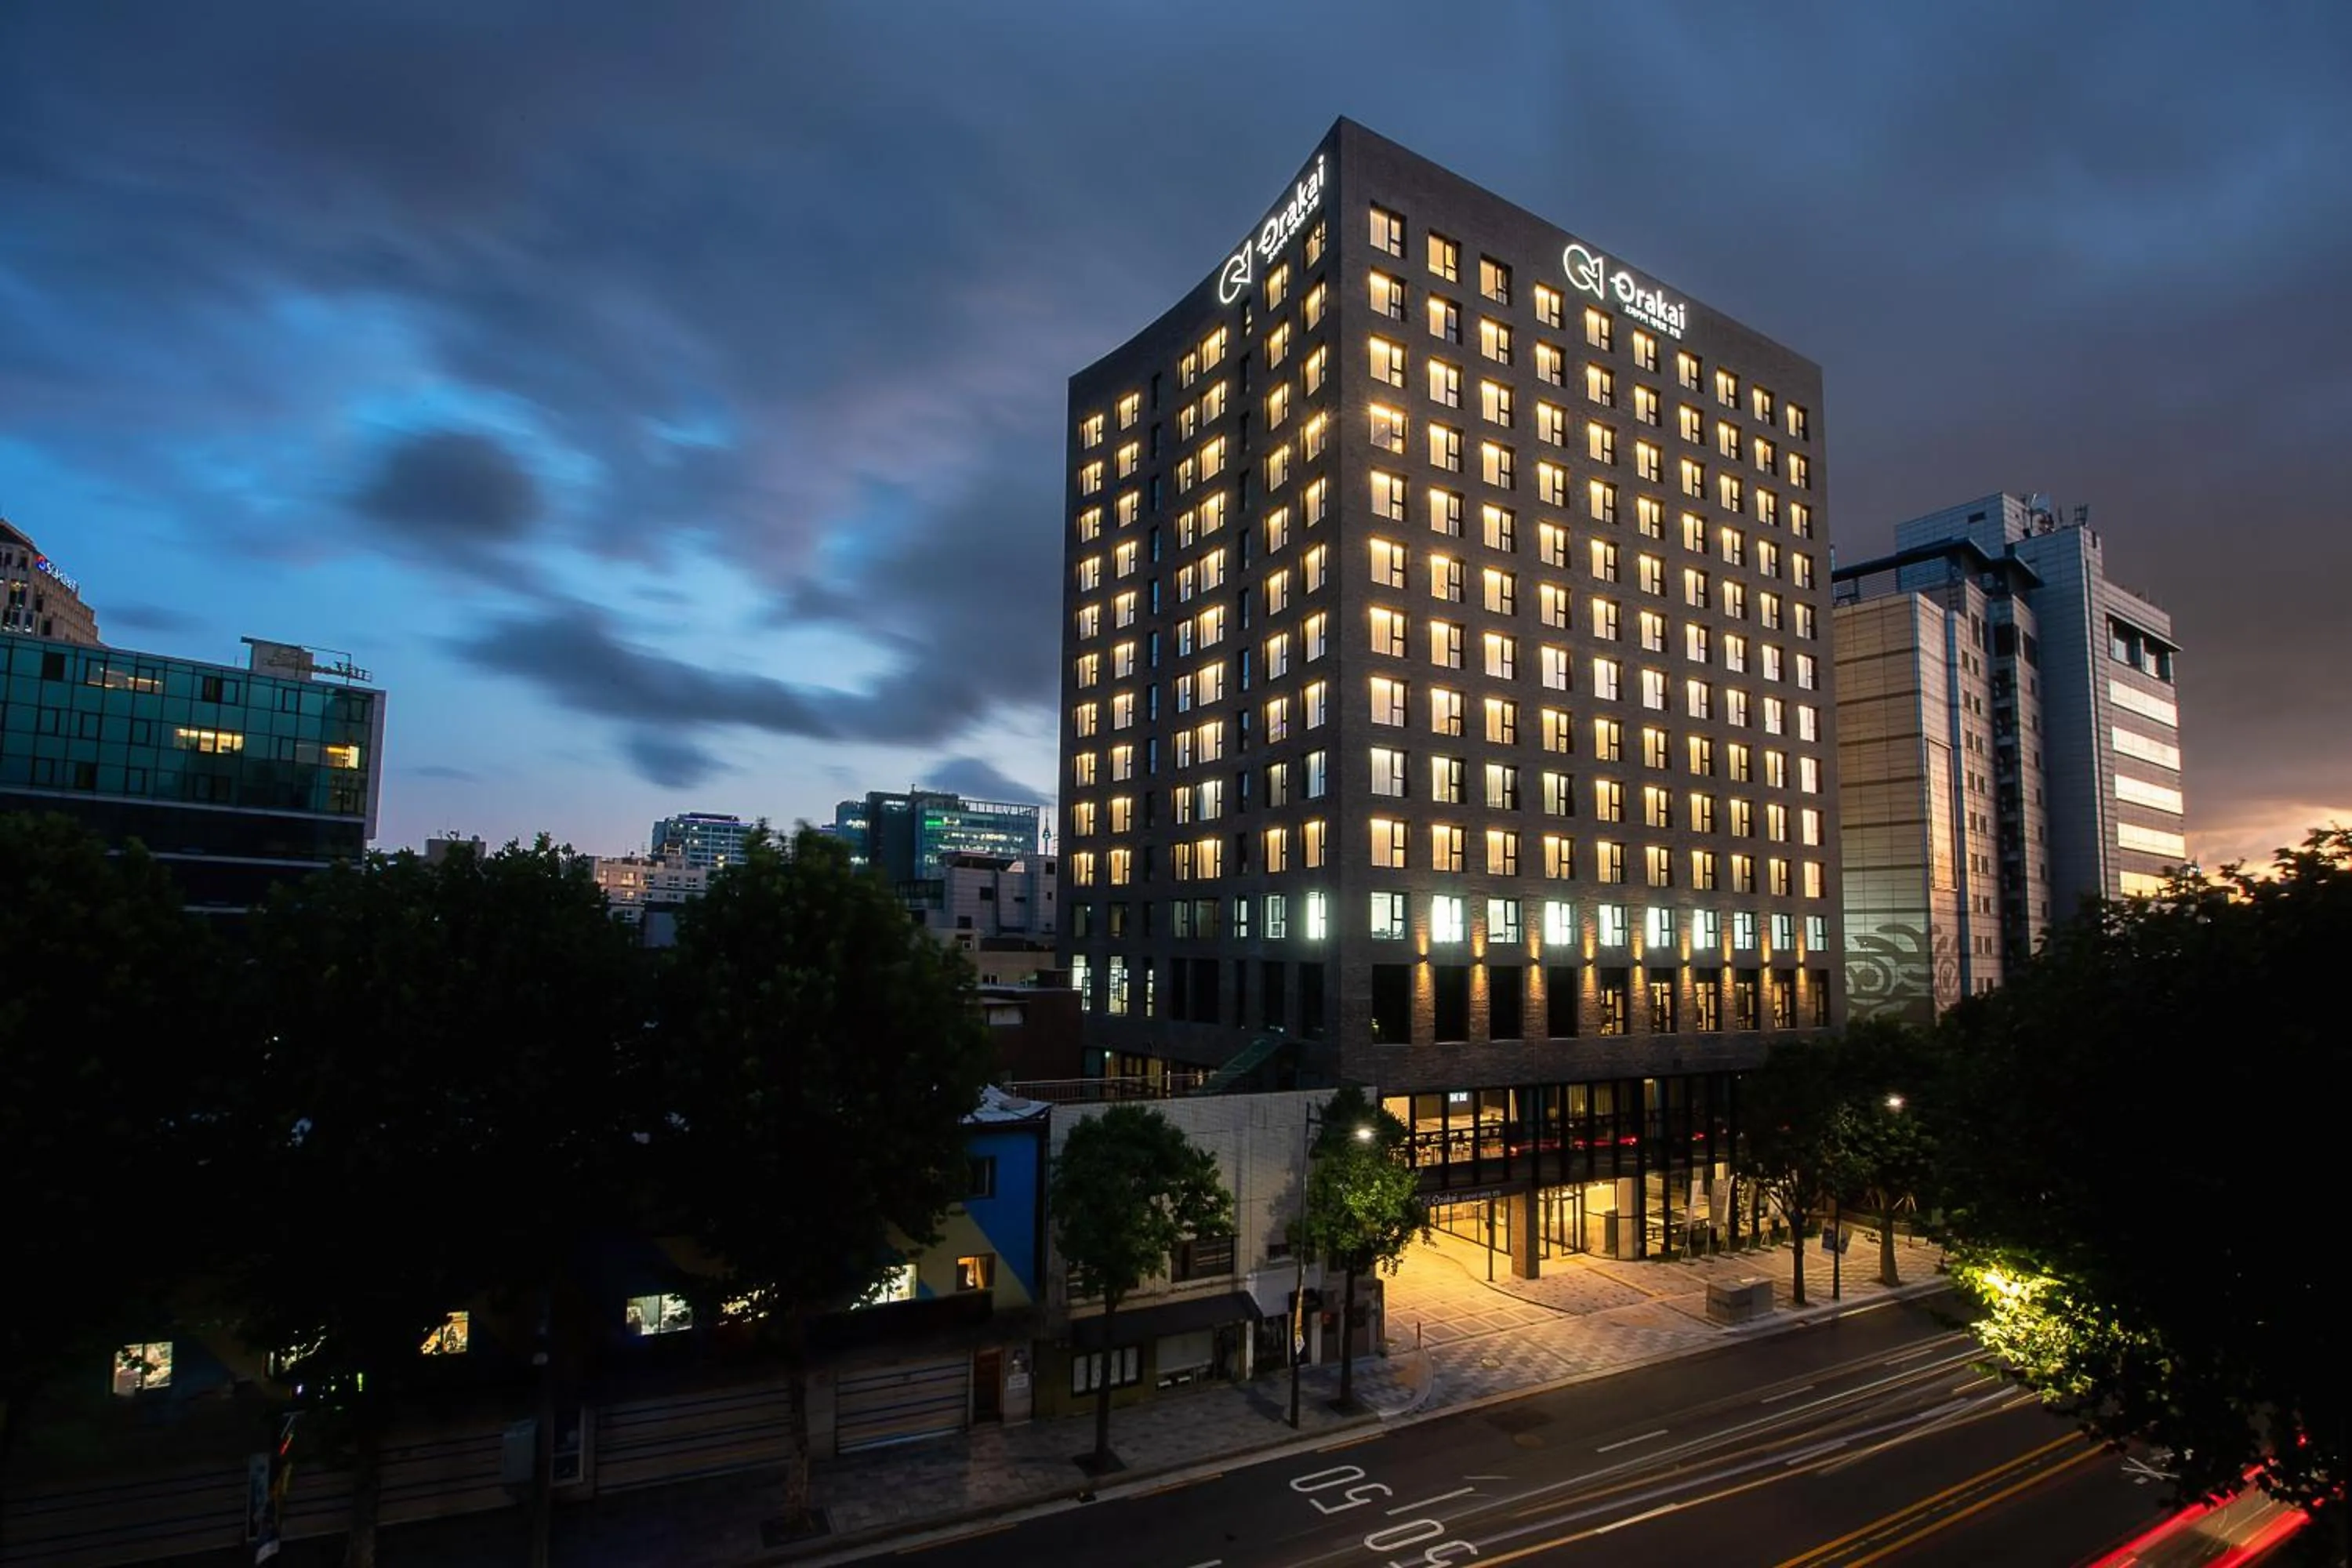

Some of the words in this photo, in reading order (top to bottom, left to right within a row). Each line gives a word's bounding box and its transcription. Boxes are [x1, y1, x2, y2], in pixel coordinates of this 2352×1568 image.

[1256, 154, 1324, 255] Orakai
[1610, 271, 1685, 330] Orakai
[1290, 1465, 1393, 1515] 50
